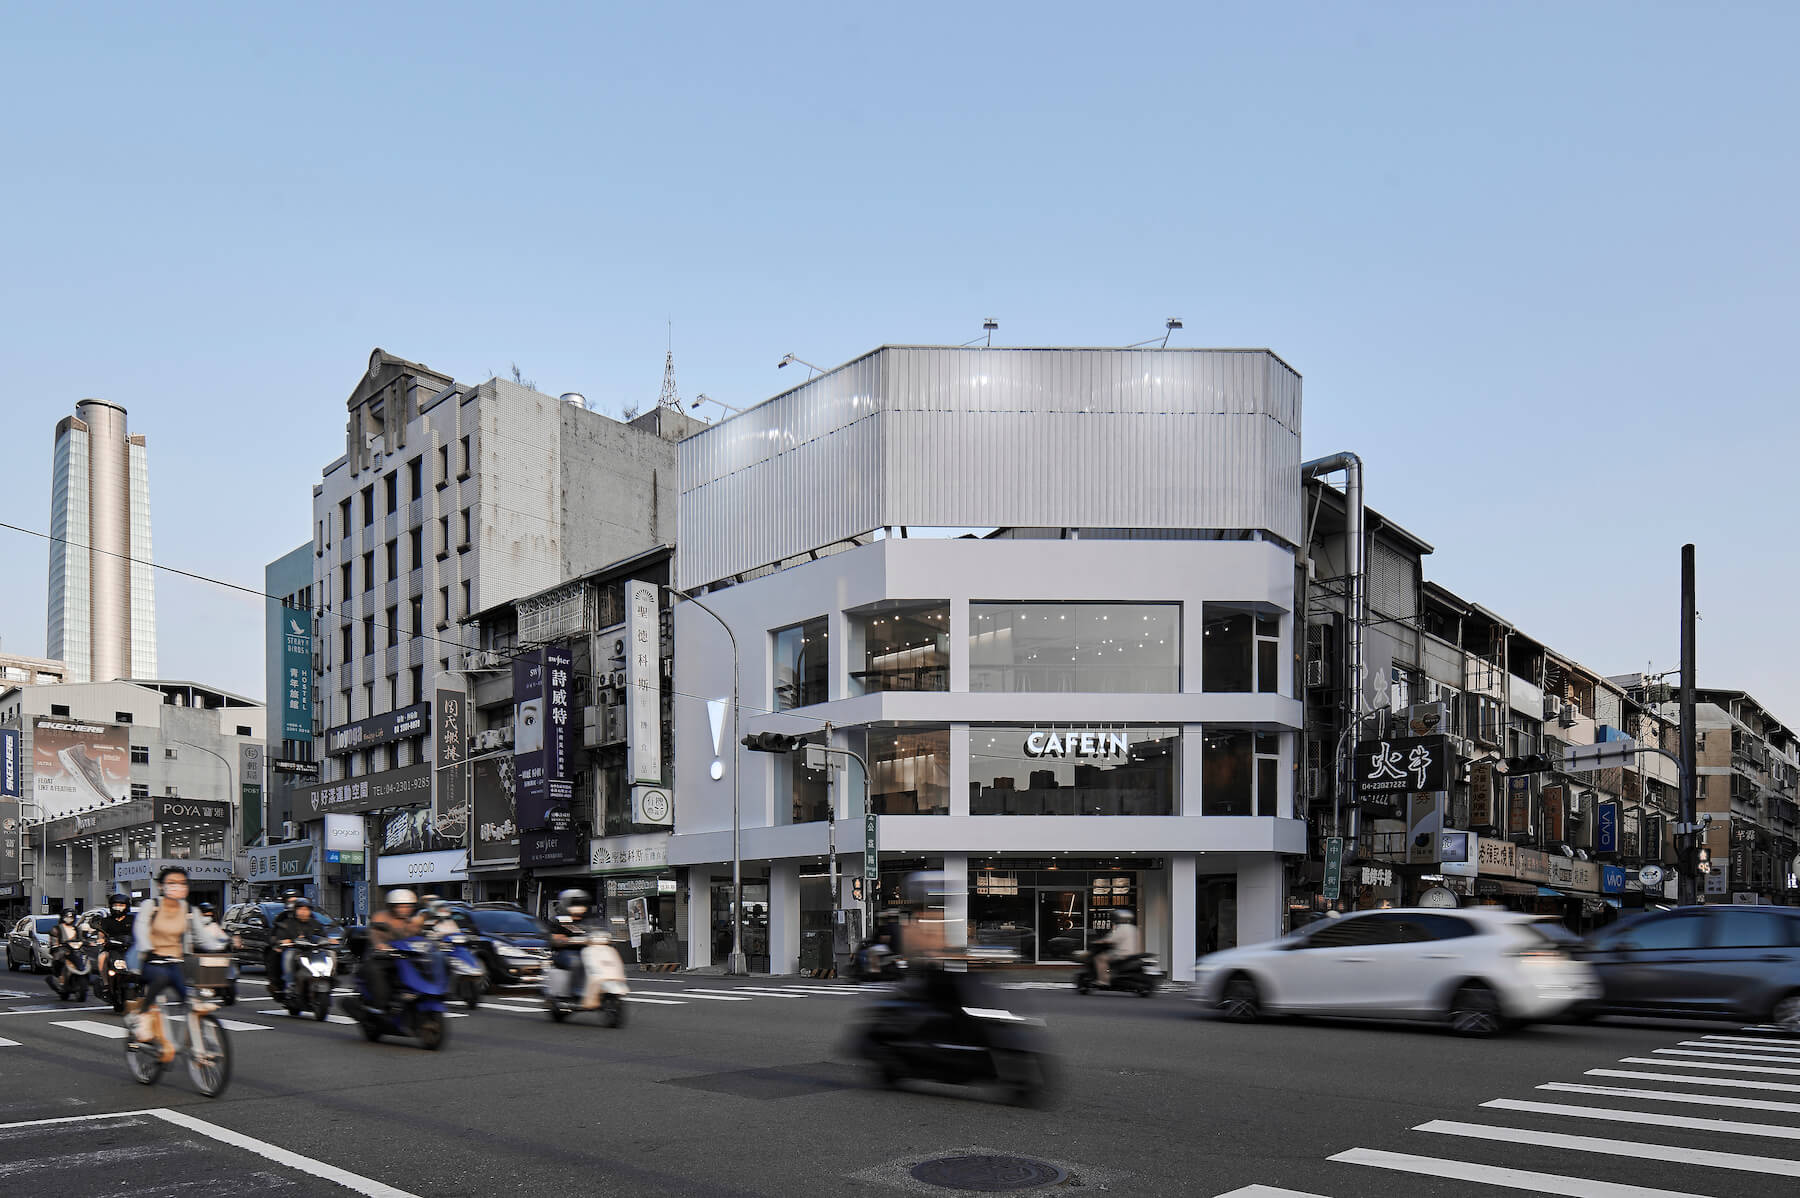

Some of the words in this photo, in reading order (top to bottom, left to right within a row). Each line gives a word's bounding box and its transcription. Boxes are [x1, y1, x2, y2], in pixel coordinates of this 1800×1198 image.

[288, 637, 304, 646] STRAY
[288, 645, 304, 654] BIRDS
[289, 667, 299, 710] 青年旅館
[551, 669, 568, 725] 詩威特
[37, 721, 105, 734] SKECHERS
[163, 803, 201, 816] POYA
[1601, 810, 1614, 846] vivo
[867, 822, 875, 865] 公益路
[282, 860, 299, 873] POST
